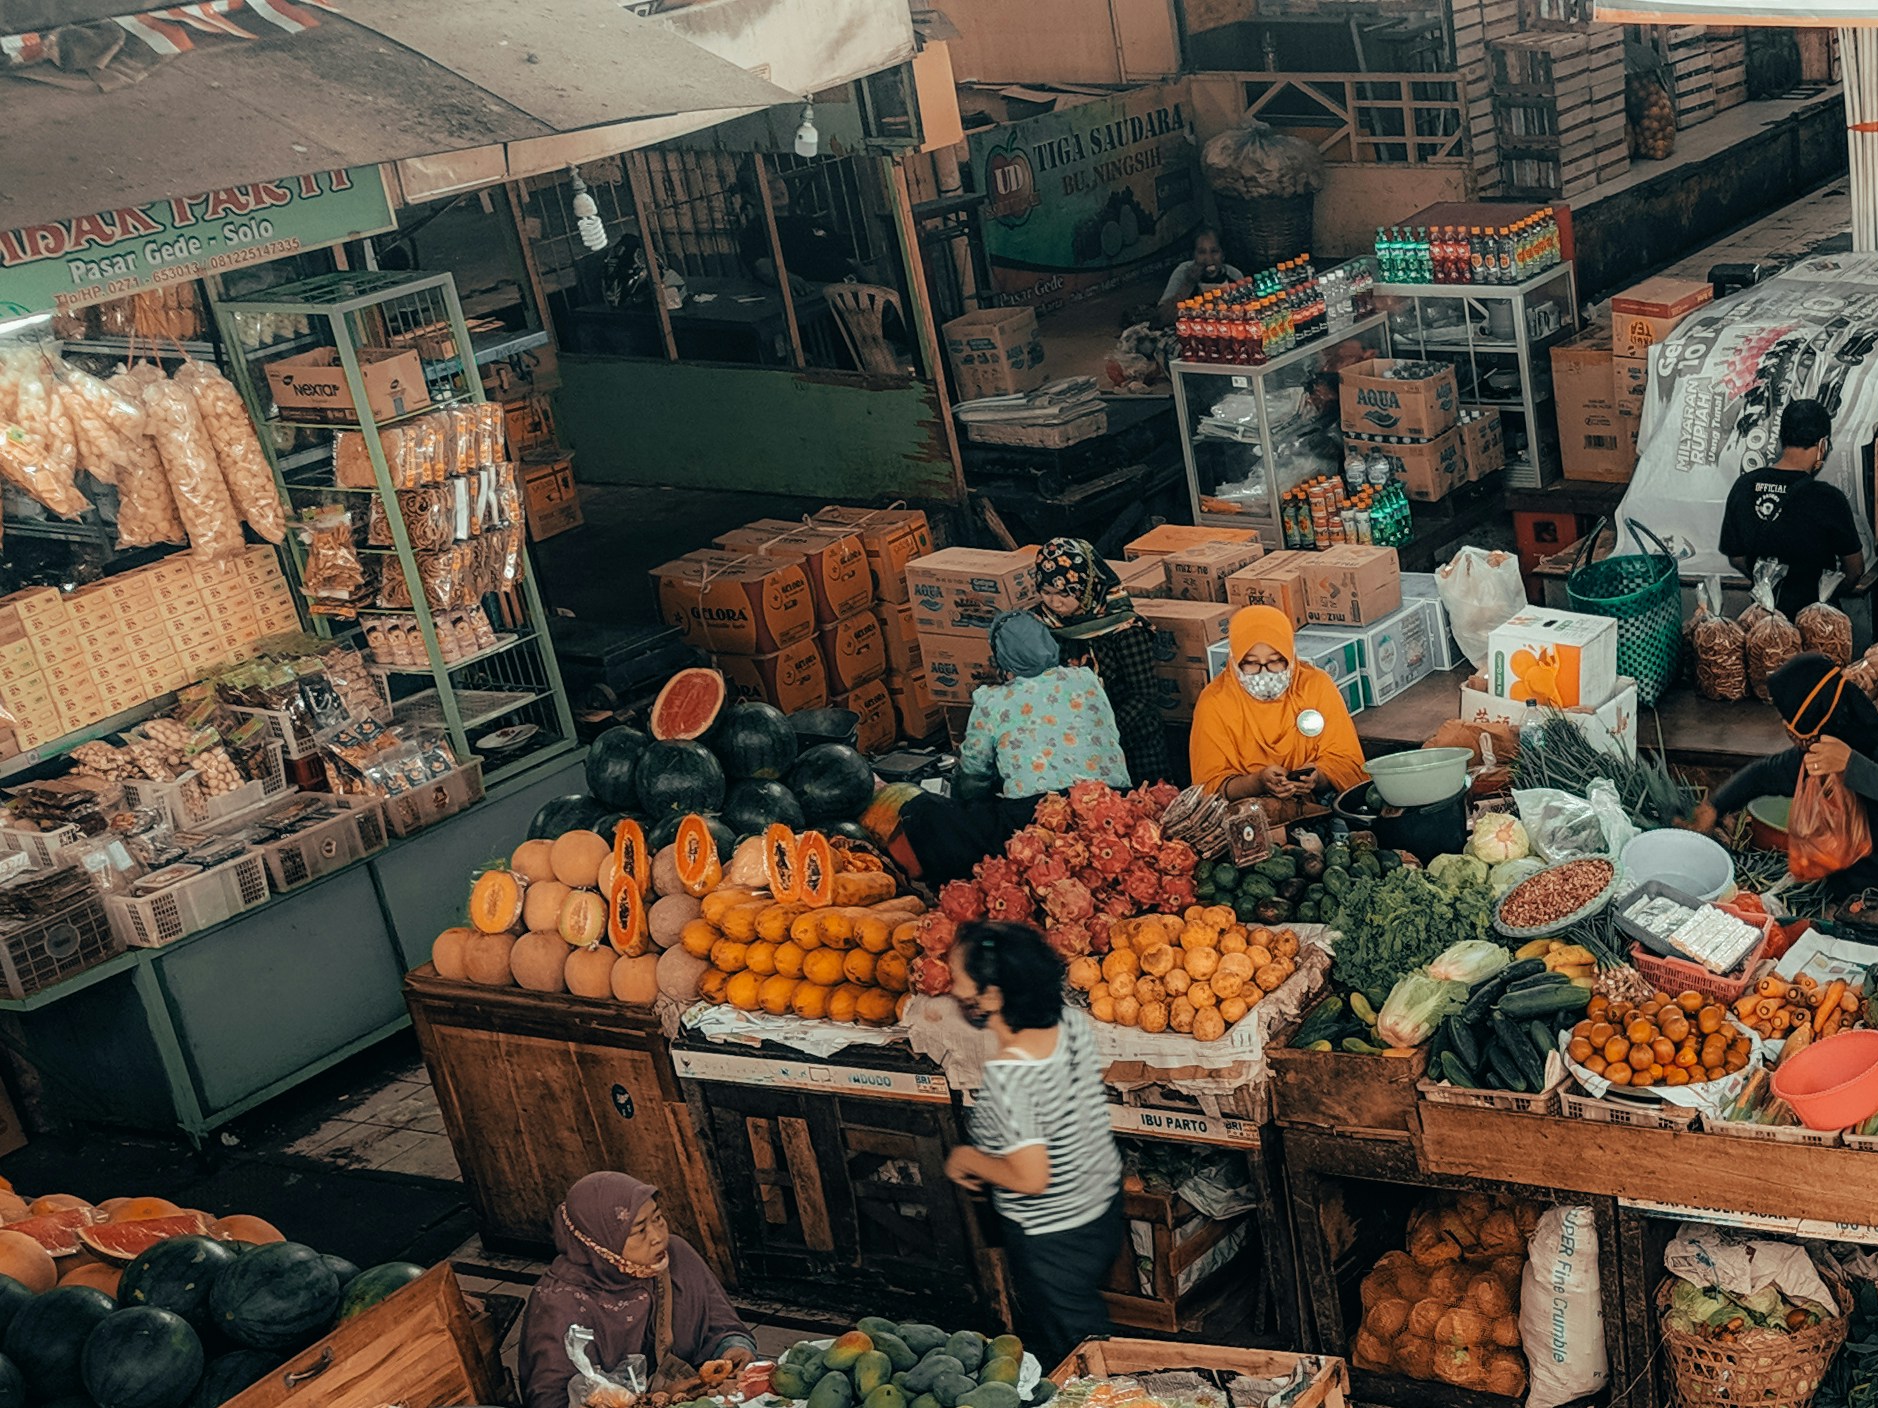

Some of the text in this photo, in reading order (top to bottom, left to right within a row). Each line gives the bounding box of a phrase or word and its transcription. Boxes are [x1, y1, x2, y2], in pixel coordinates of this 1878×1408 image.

[1032, 103, 1185, 173] TIGA SAUDARA
[993, 164, 1023, 195] UD
[1093, 146, 1163, 187] NINGSIH
[67, 251, 138, 285] Pasar
[143, 235, 201, 264] Gede
[222, 216, 274, 245] Solo
[107, 277, 141, 295] 0271
[151, 263, 200, 284] 653013
[210, 238, 300, 269] 081225147335
[1034, 274, 1065, 297] Gede
[1630, 322, 1652, 337] TEA
[1356, 387, 1401, 410] AQUA
[1675, 379, 1700, 472] MILYARAN
[1690, 391, 1712, 465] RUPIAH
[1708, 430, 1721, 463] Uang
[914, 584, 944, 599] AQUA
[691, 606, 748, 622] GELORA
[931, 662, 960, 676] AQUA
[915, 1074, 931, 1085] BRI
[1140, 1113, 1208, 1133] IBU PARTO
[1558, 1258, 1574, 1290] Fine
[1550, 1288, 1569, 1365] Crumble
